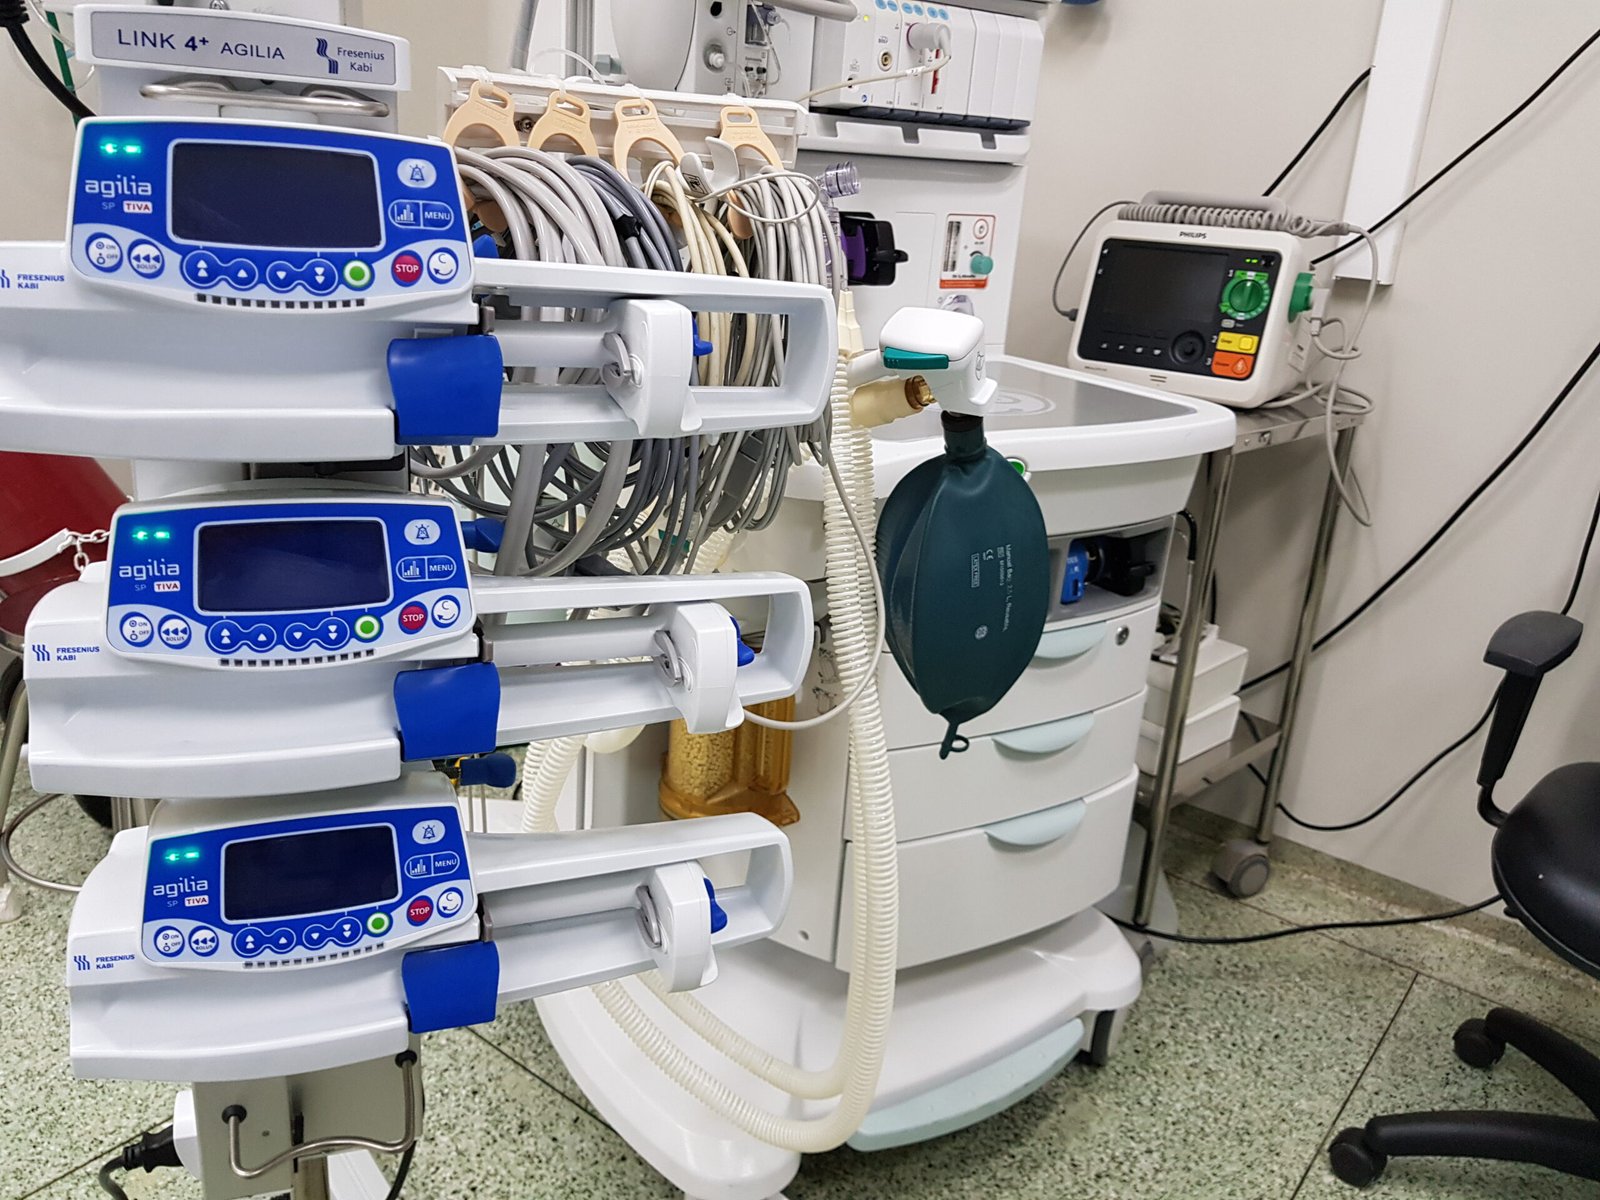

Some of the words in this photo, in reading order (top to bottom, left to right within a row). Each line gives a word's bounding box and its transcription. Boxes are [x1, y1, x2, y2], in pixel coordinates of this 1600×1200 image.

[118, 28, 176, 50] LINK
[220, 42, 285, 60] AGILIA
[337, 46, 385, 61] Fresenius
[349, 61, 373, 73] Kabi
[85, 174, 152, 198] agilia
[101, 201, 116, 210] SP
[125, 202, 151, 211] TIVA
[424, 211, 451, 220] MENU
[1179, 231, 1207, 239] PHILIPS
[395, 264, 420, 273] STOP
[17, 273, 65, 282] FRESENIUS
[1211, 335, 1218, 343] 2
[1205, 357, 1212, 366] 3
[1005, 543, 1013, 568] Manual
[118, 558, 180, 580] agilia
[429, 564, 453, 572] MENU
[155, 583, 179, 591] TIVA
[402, 613, 424, 622] STOP
[56, 646, 100, 654] FRESENIUS
[434, 858, 457, 868] MENU
[153, 875, 208, 898] agilia
[167, 900, 178, 908] SP
[186, 897, 208, 905] TIVA
[410, 906, 430, 916] STOP
[95, 953, 136, 963] FRESENIUS
